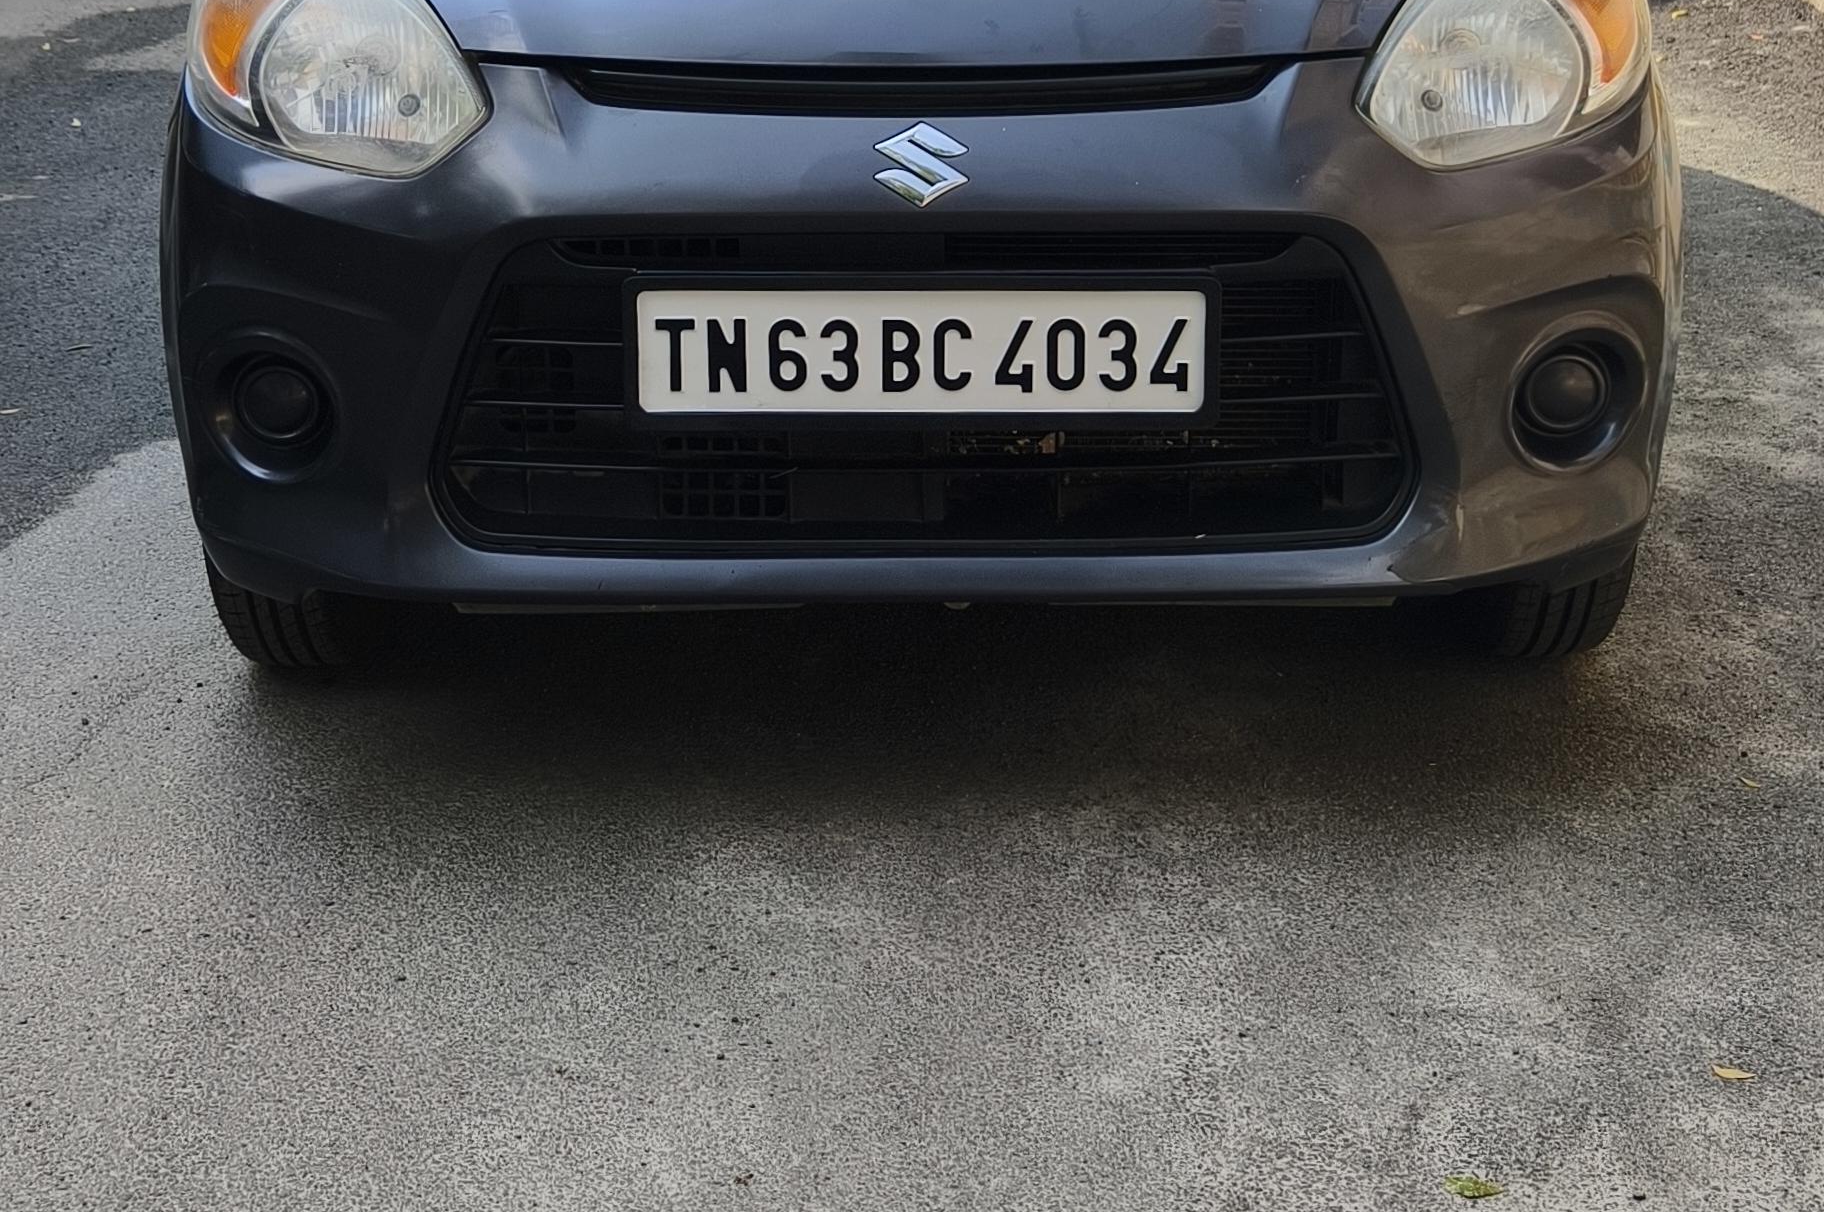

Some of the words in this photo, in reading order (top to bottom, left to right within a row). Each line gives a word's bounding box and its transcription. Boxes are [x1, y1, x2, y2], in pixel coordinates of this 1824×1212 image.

[655, 319, 747, 392] TN
[768, 319, 859, 391] 63
[882, 319, 972, 392] BC
[995, 319, 1188, 392] 4034
